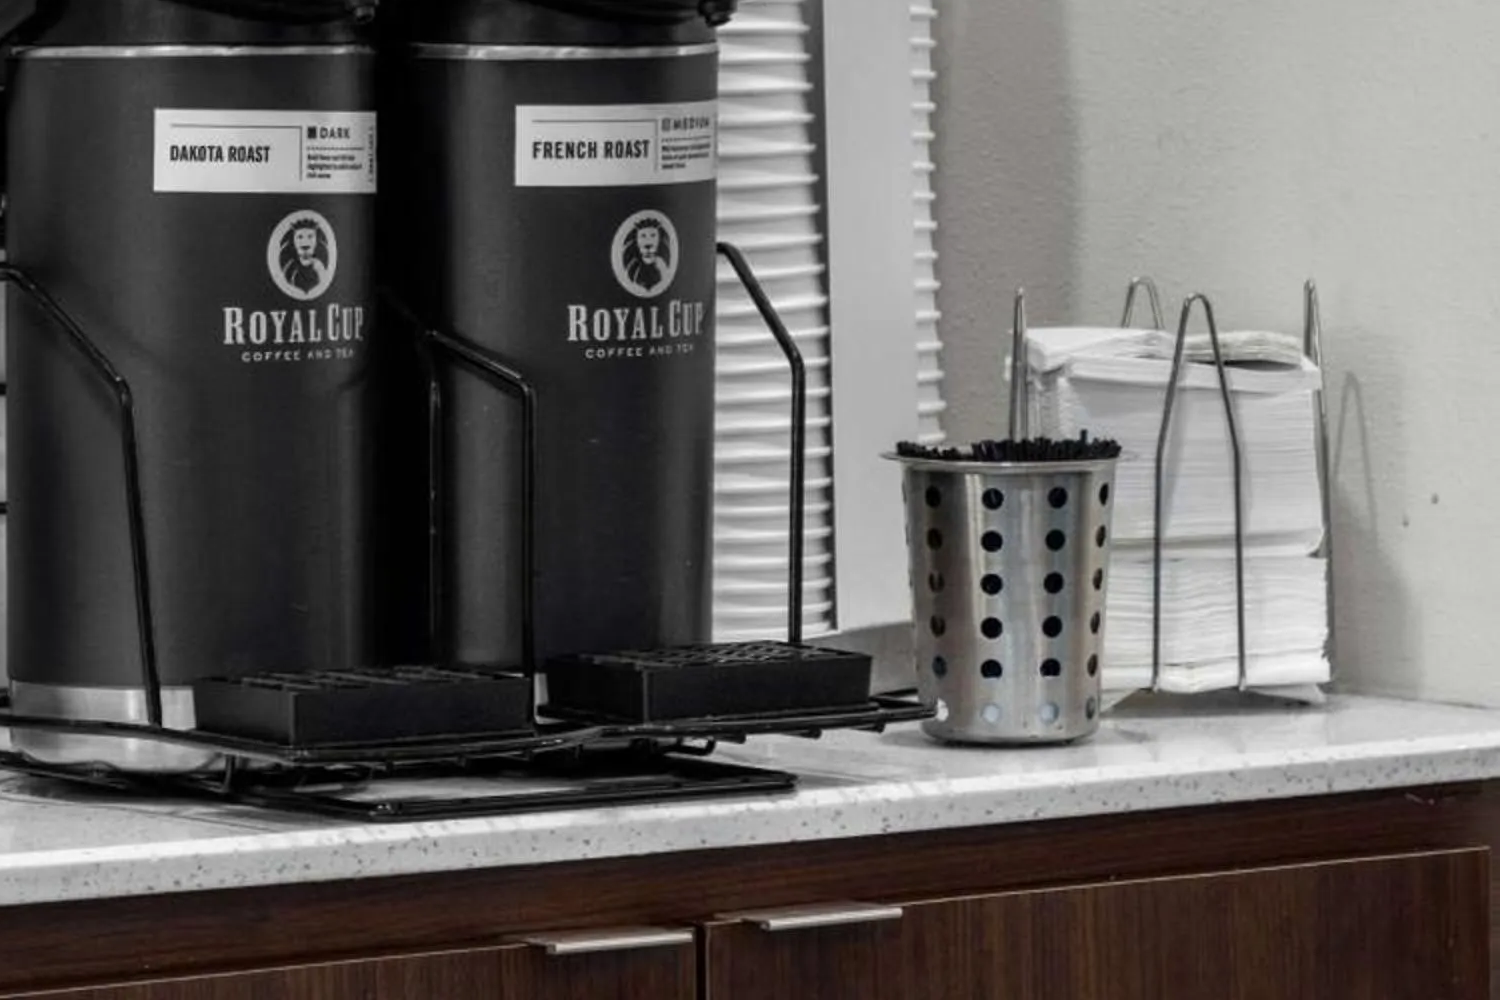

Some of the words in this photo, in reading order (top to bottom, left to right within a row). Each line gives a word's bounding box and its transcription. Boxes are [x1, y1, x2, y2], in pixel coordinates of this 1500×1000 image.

[673, 117, 710, 130] MEDIUM
[320, 126, 351, 139] DARK
[169, 145, 224, 163] DAKOTA
[228, 146, 271, 163] ROAST
[532, 141, 598, 159] FRENCH
[603, 139, 650, 159] ROAST
[222, 306, 322, 345] ROYAL
[327, 302, 364, 342] CUP
[567, 304, 663, 341] ROYAL
[669, 300, 704, 337] CUP
[241, 351, 301, 363] COFFEE
[307, 349, 332, 360] AND
[585, 347, 643, 359] COFFEE
[650, 346, 673, 355] AND
